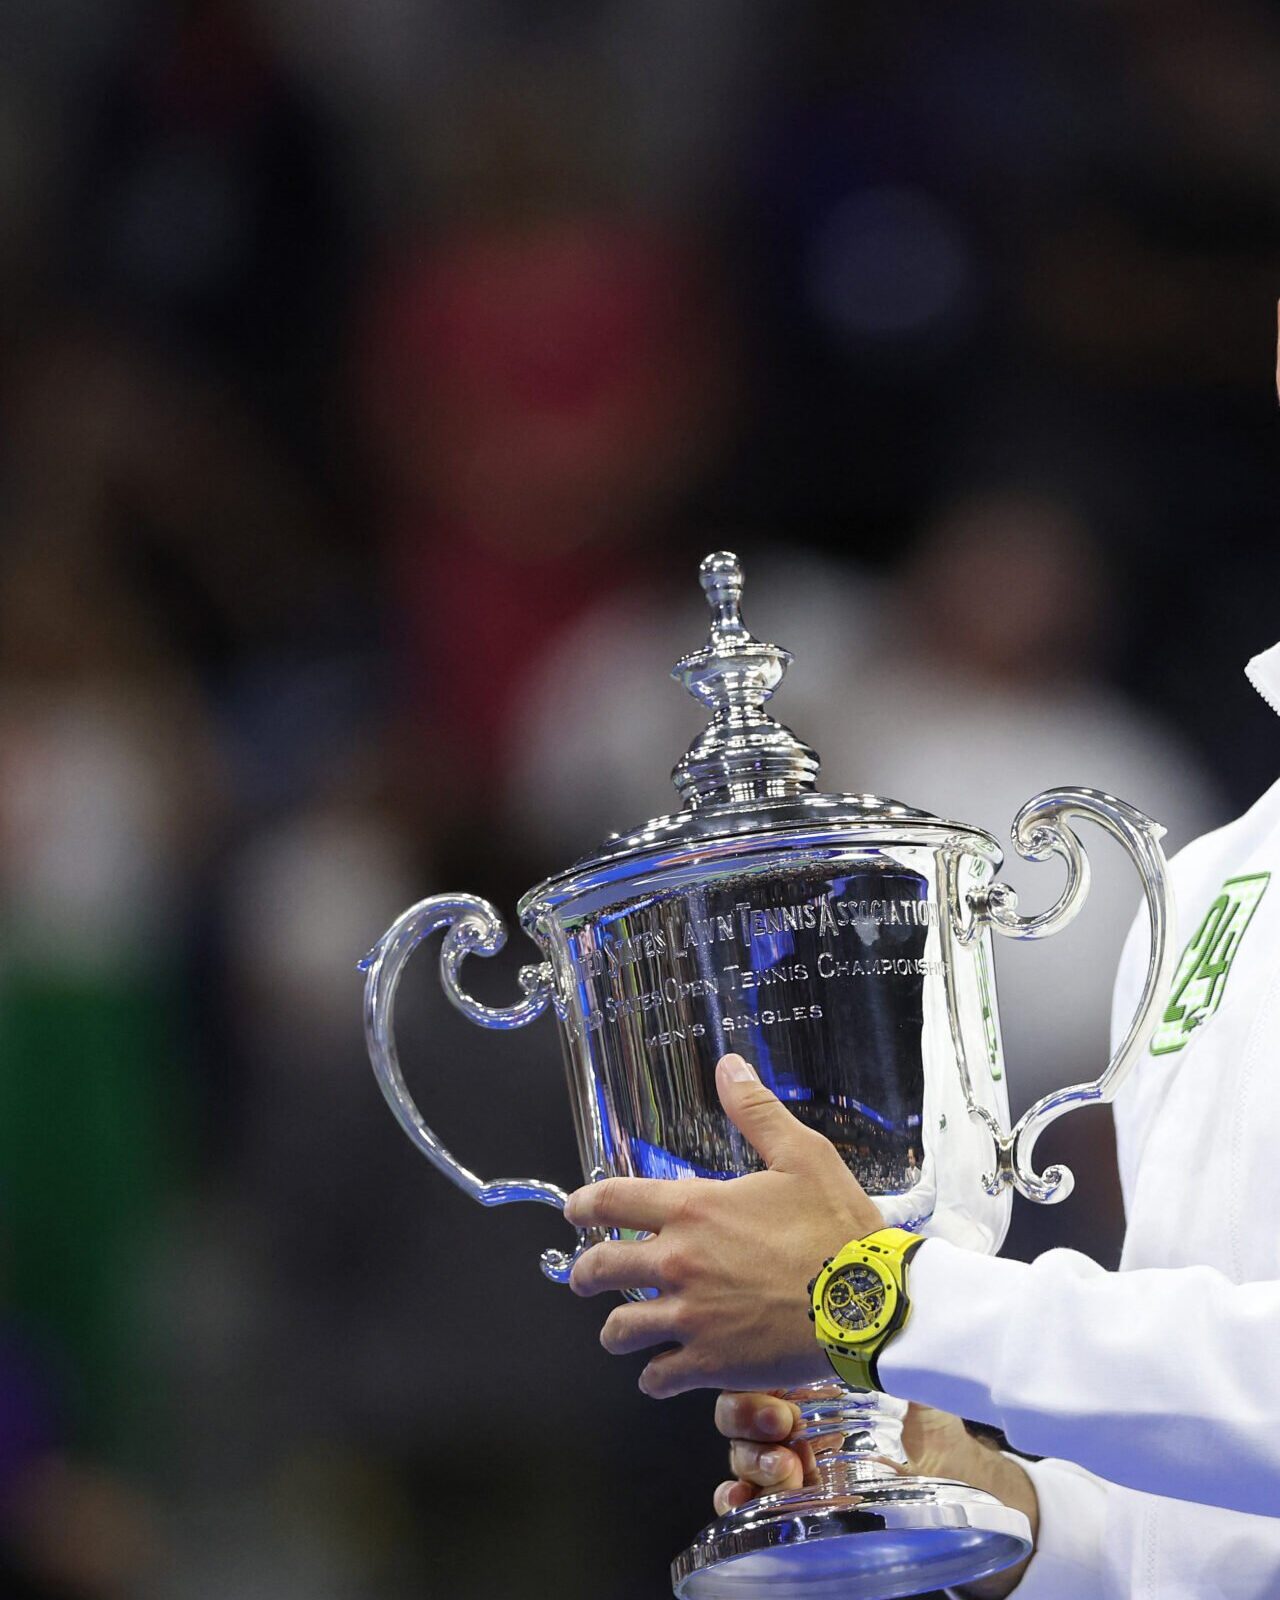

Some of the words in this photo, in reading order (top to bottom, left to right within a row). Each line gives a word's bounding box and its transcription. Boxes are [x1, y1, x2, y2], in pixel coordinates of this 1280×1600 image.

[667, 914, 735, 959] LAWN
[736, 902, 816, 946] TENNIS
[819, 894, 939, 937] ASSOCIATION
[664, 977, 718, 1003] OPEN
[723, 962, 809, 990] TENNIS
[1163, 894, 1241, 1023] 24
[645, 1023, 705, 1046] MEN'S
[722, 1005, 823, 1031] SINGLES
